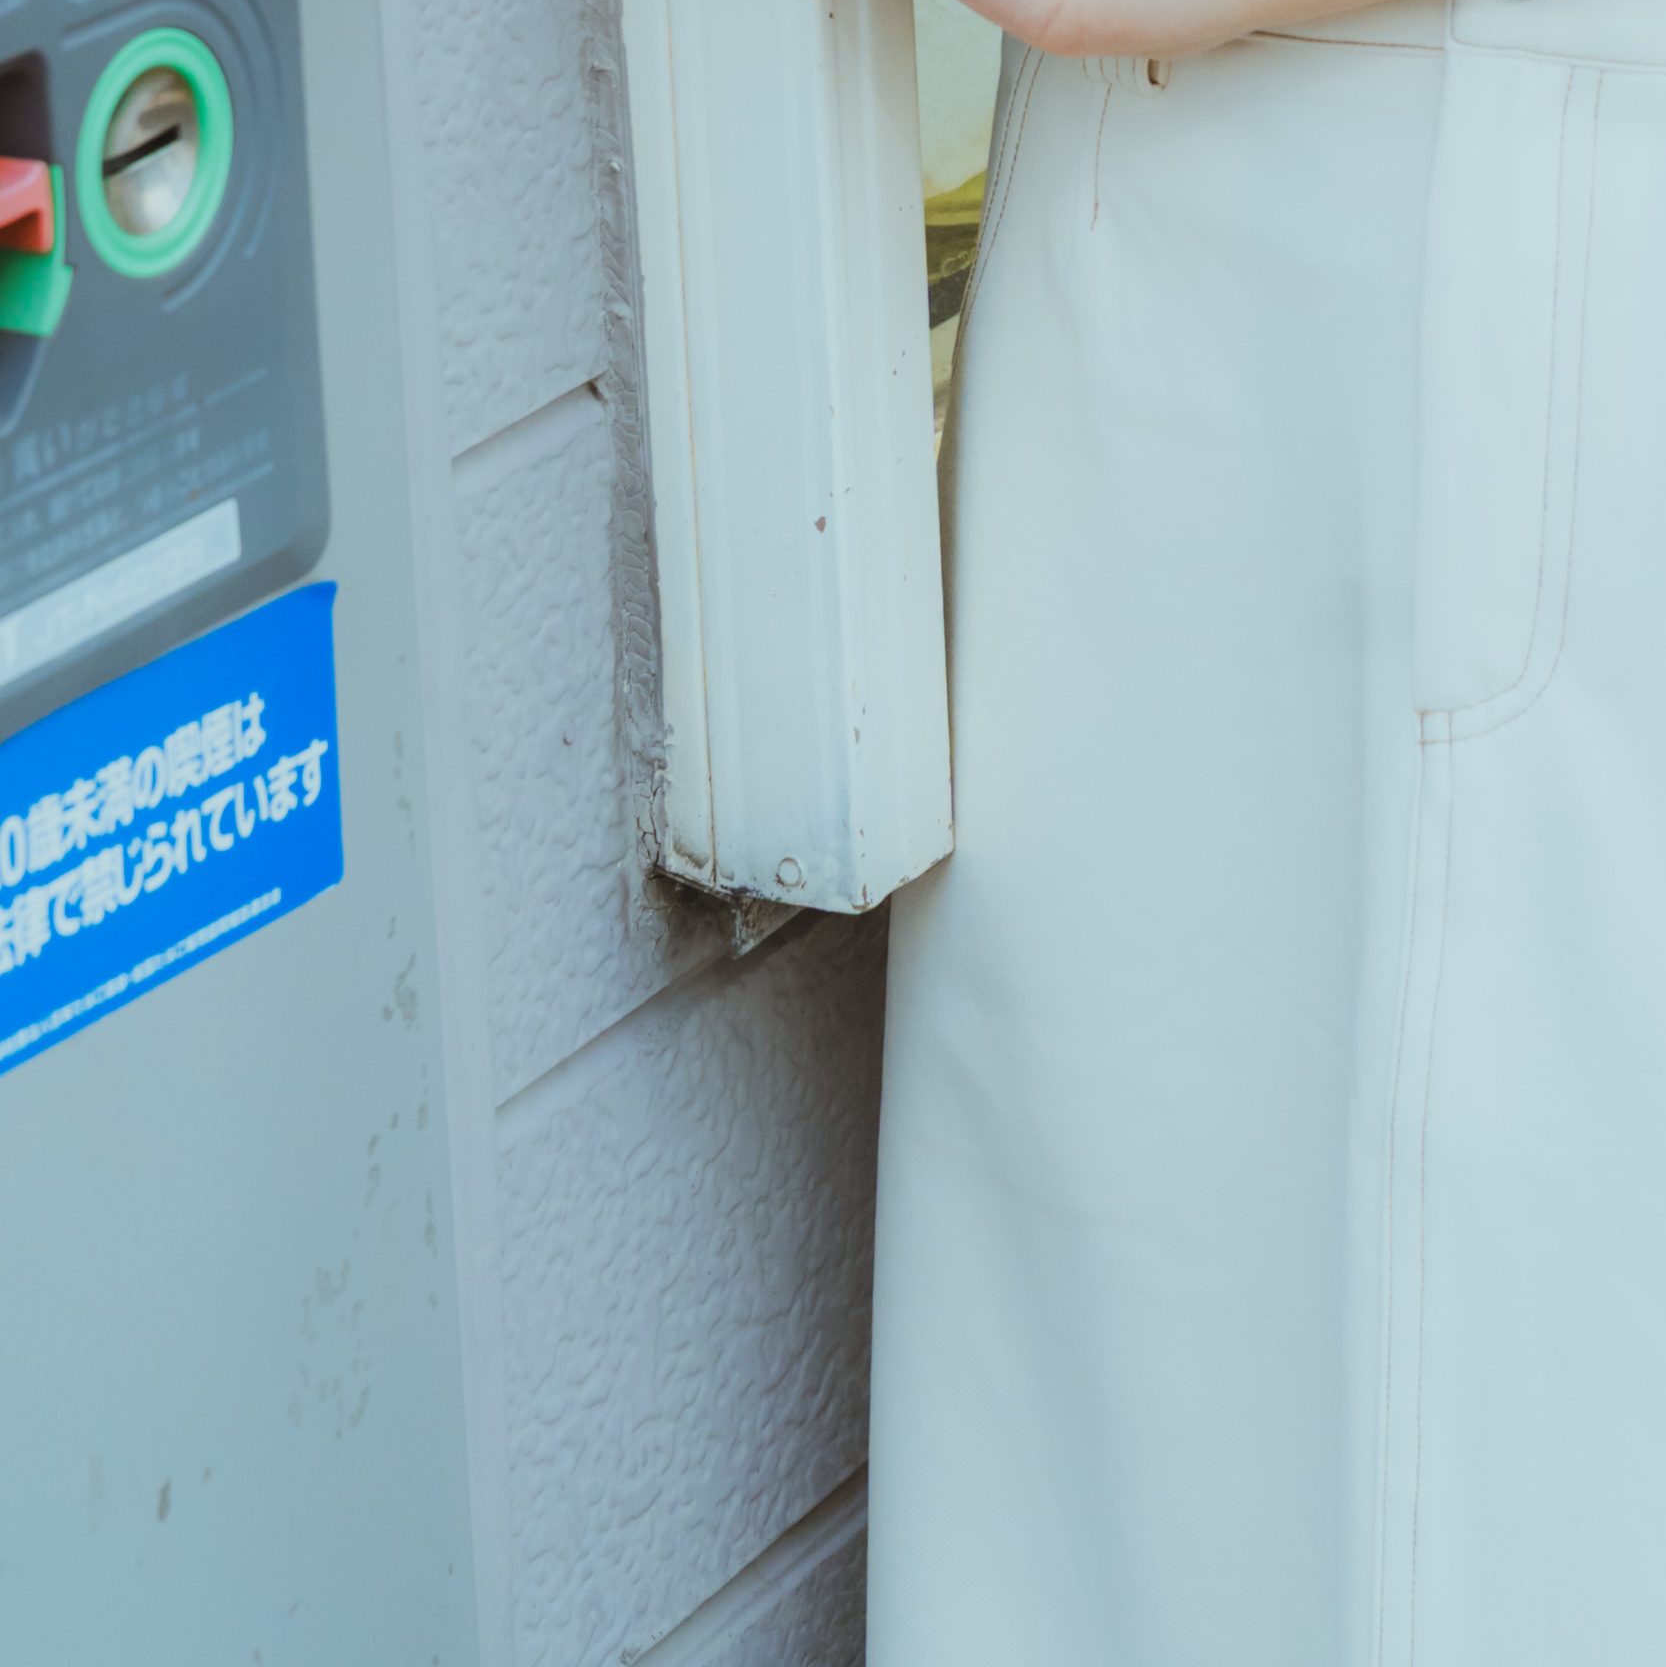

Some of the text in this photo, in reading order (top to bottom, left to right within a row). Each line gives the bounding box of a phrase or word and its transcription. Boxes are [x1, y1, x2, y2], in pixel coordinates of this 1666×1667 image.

[0, 691, 266, 891] 0歳未満の喫煙は
